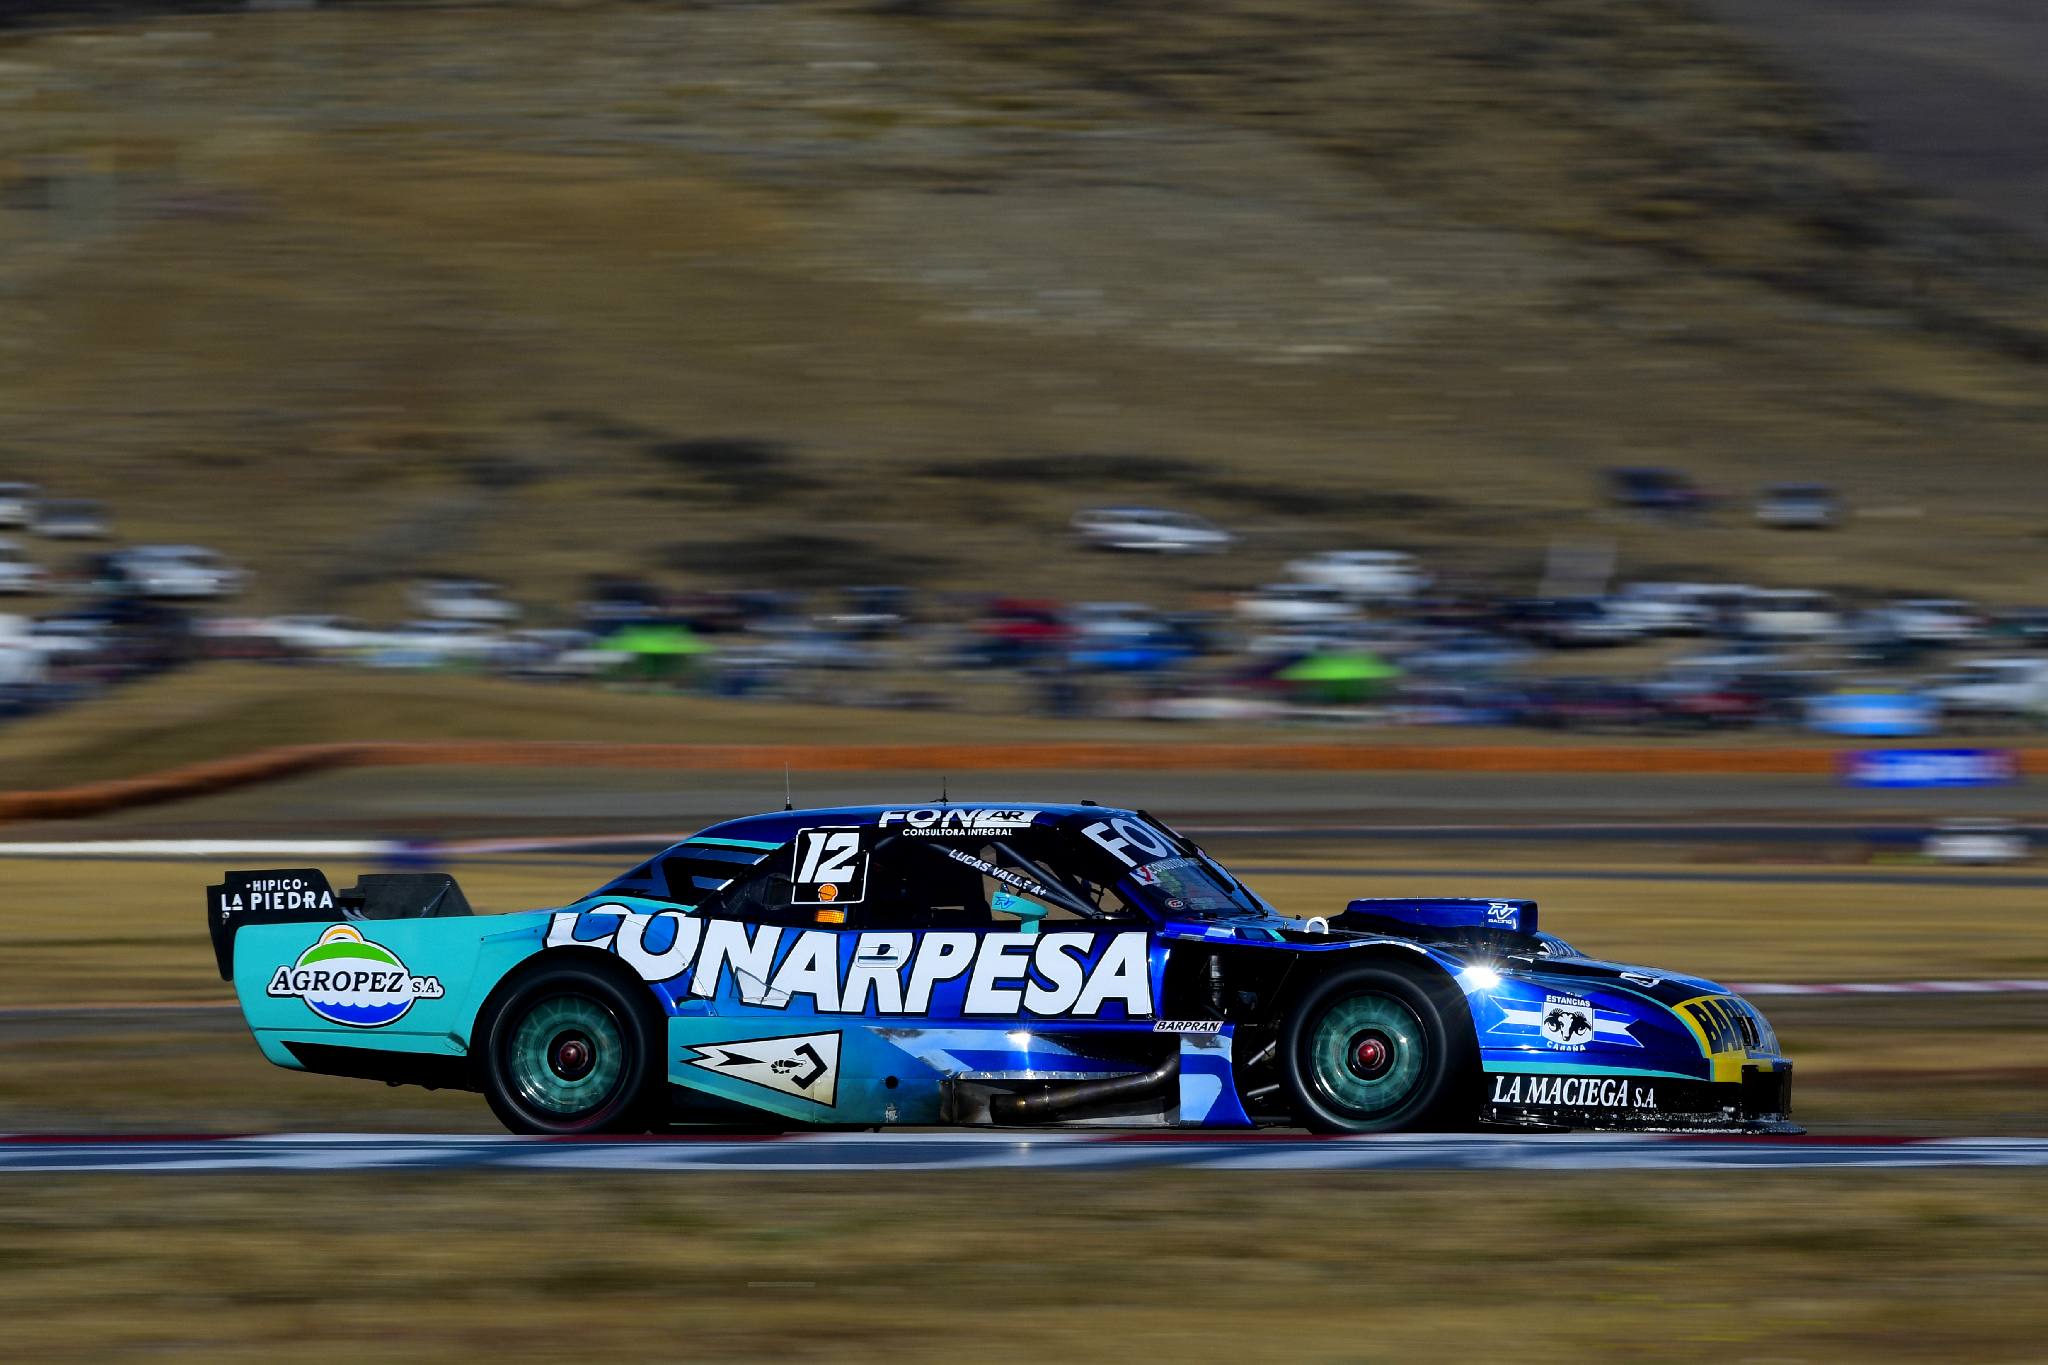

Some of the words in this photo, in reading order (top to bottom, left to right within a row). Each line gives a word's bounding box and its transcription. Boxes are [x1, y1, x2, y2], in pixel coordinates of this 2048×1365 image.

[902, 828, 966, 836] CONSULTORA
[967, 828, 1013, 836] INTEGRAL
[797, 832, 860, 883] 12
[948, 848, 993, 872] LUCAS
[252, 879, 301, 892] HIPICO
[221, 893, 244, 911] LA
[250, 890, 334, 911] PIEDRA
[545, 901, 1153, 1016] CONARPESA
[271, 970, 405, 993] AGROPEZ
[411, 980, 441, 994] S.A.
[1546, 994, 1591, 1008] ESTANCIAS
[1156, 1021, 1219, 1032] BARPRAN
[1492, 1075, 1521, 1103] LA
[1525, 1076, 1628, 1107] MACIEGA
[1633, 1087, 1657, 1109] S.A.
